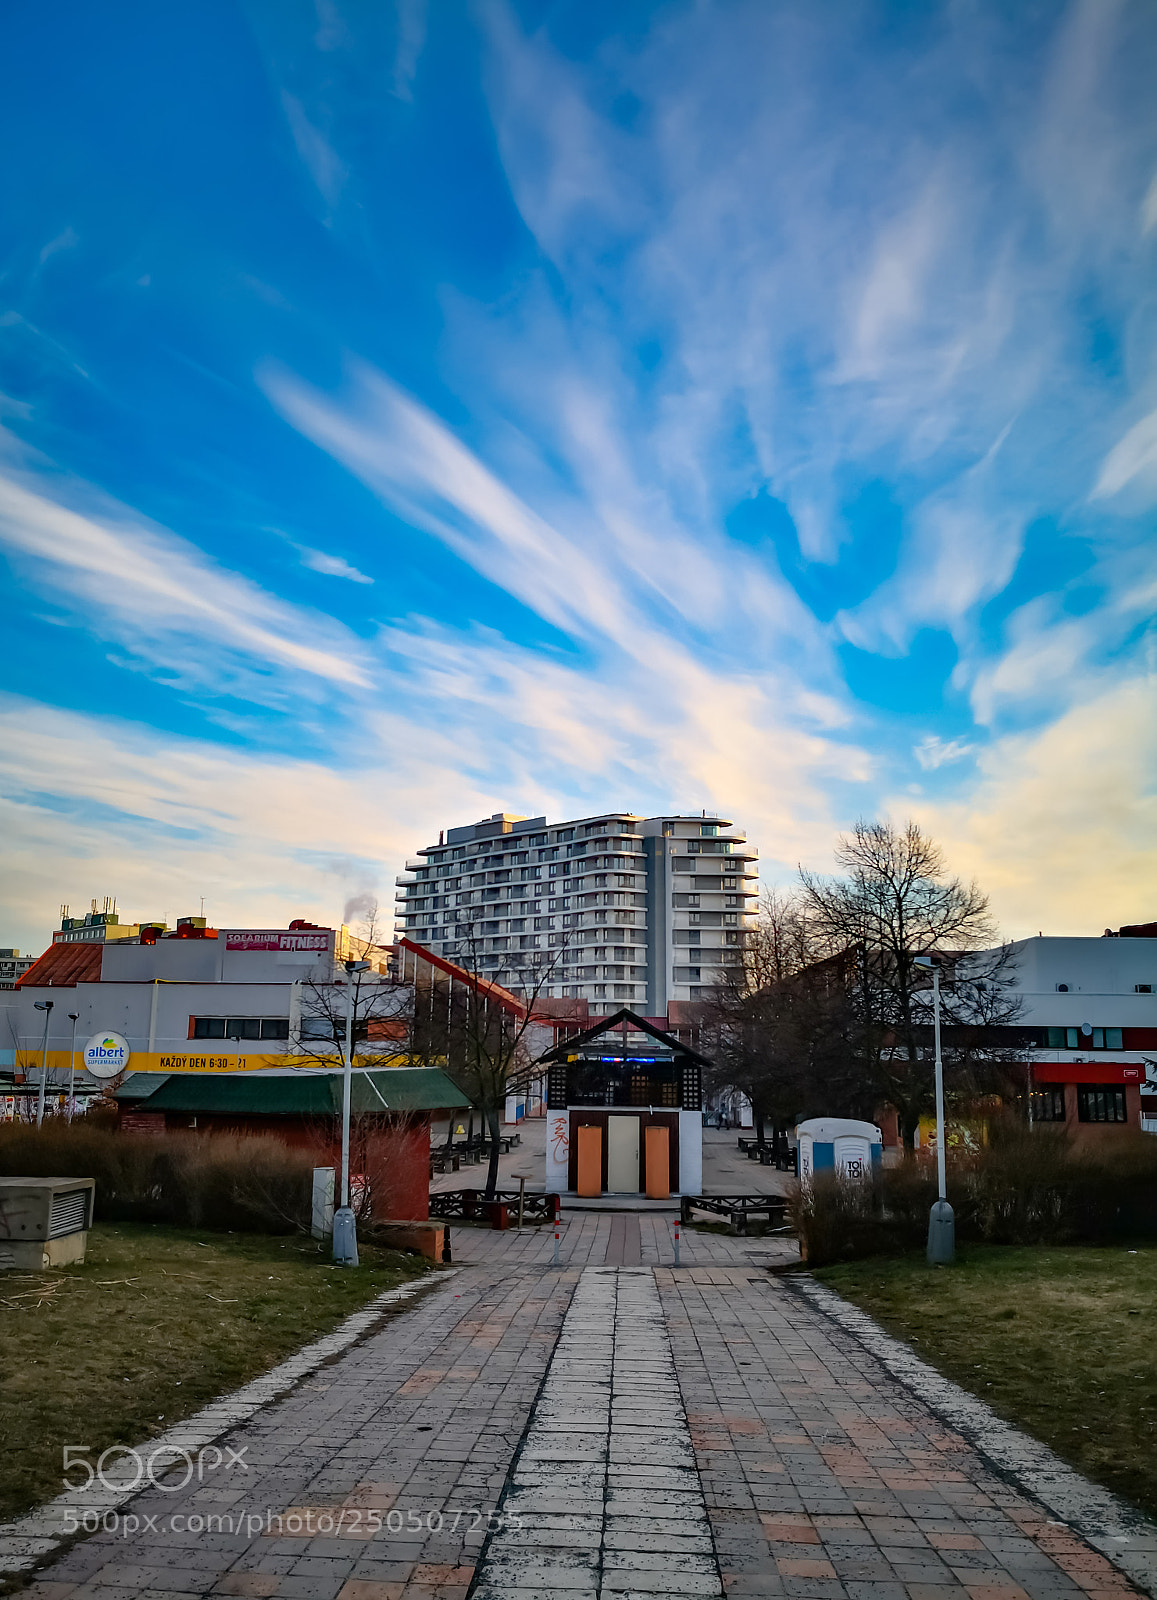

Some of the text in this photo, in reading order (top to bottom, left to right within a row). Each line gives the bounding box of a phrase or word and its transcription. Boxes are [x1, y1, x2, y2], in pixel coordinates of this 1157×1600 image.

[228, 934, 279, 943] SOLARIUM
[280, 936, 327, 949] FITNESS
[88, 1046, 124, 1058] albert
[160, 1055, 188, 1068] KAŽDÝ
[189, 1057, 206, 1068] DEN
[209, 1058, 228, 1068] 6:30
[237, 1058, 246, 1069] 21
